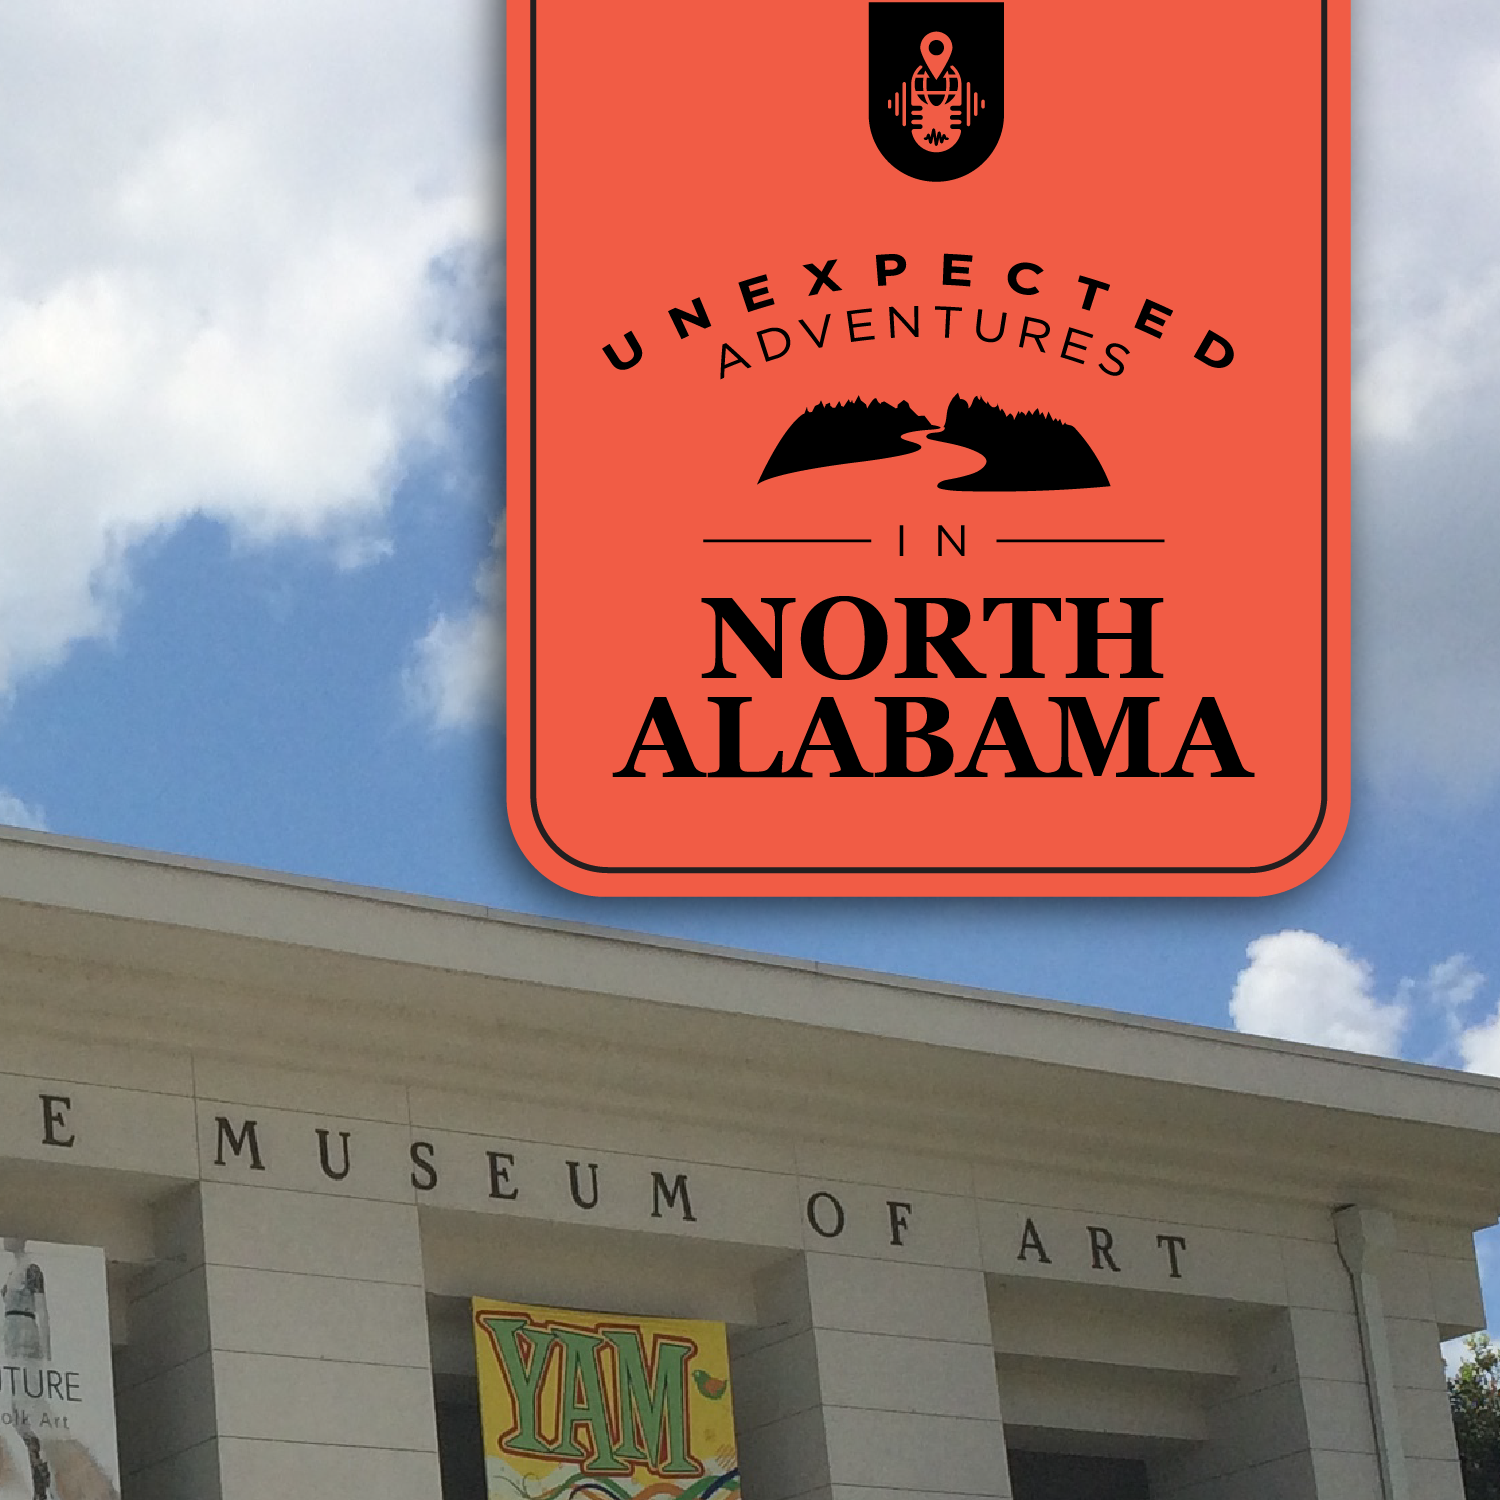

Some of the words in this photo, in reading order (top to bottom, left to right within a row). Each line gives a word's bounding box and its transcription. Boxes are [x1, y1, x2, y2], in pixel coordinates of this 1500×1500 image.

[214, 1117, 697, 1221] MUSEUM
[807, 1191, 912, 1245] OF
[1017, 1218, 1186, 1277] ART
[39, 1412, 70, 1429] Art
[476, 1310, 705, 1479] YAM
